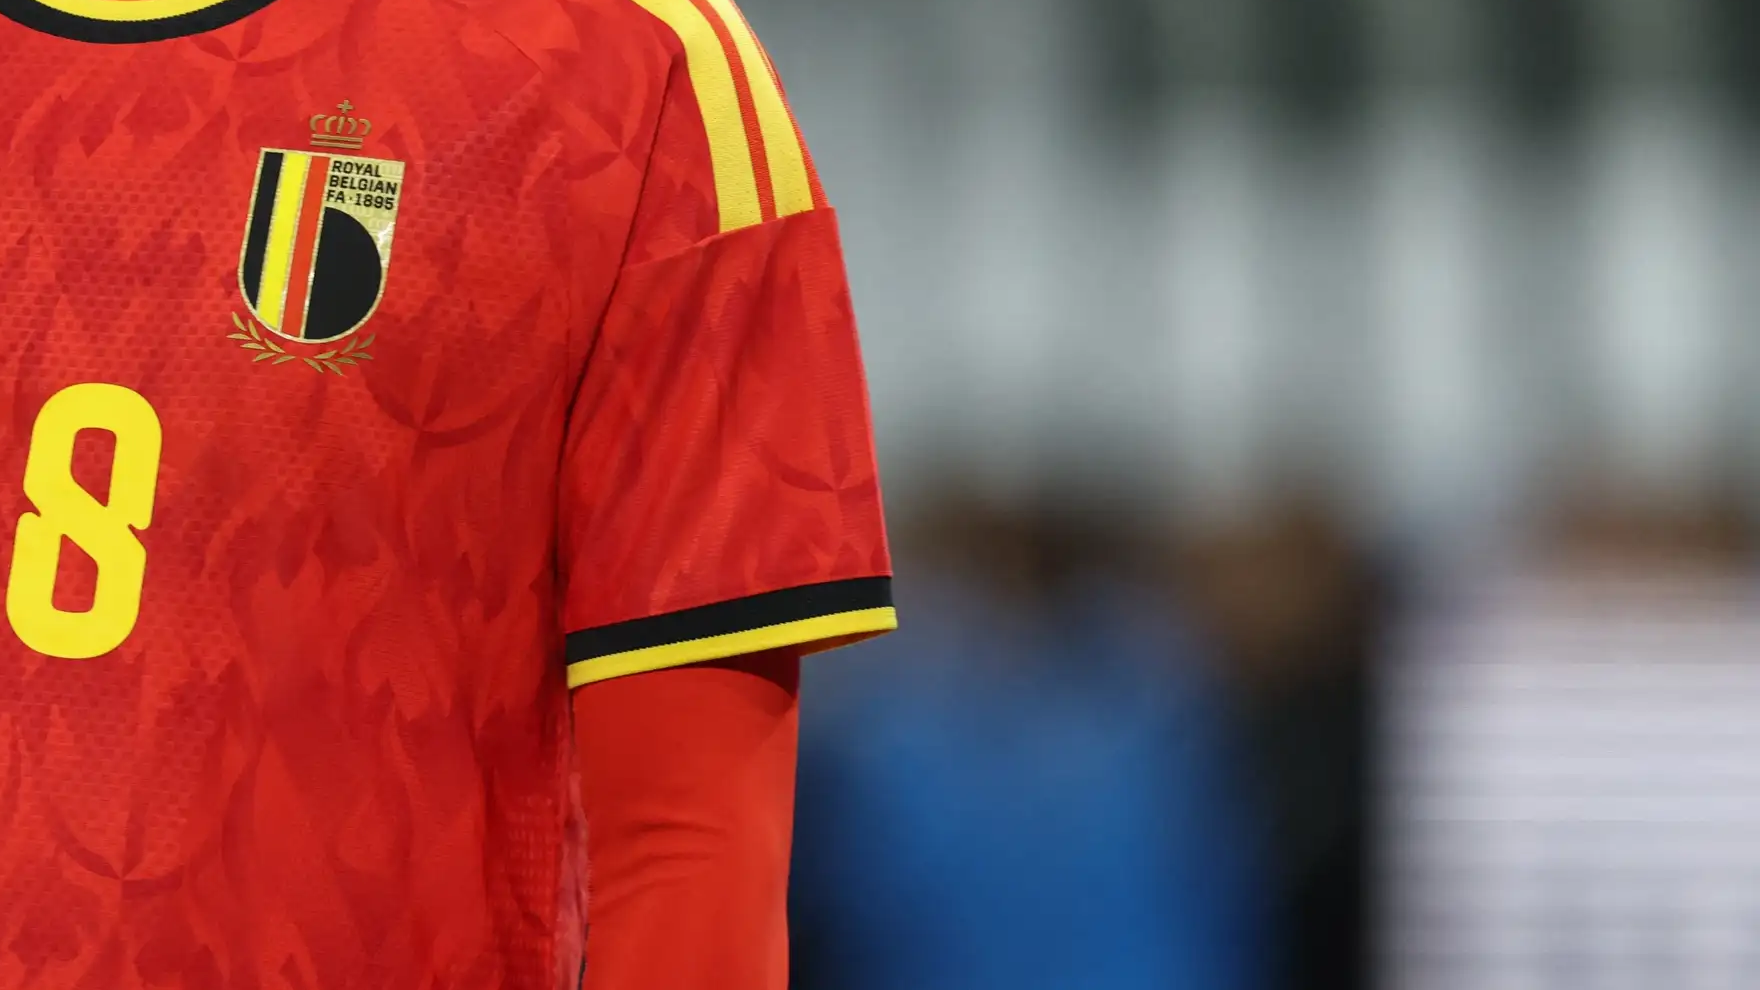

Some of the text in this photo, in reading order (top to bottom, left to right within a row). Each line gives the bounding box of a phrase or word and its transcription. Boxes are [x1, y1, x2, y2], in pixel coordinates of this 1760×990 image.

[331, 160, 381, 177] ROYAL
[329, 175, 397, 195] BELGIAN
[326, 189, 395, 210] FA 1895
